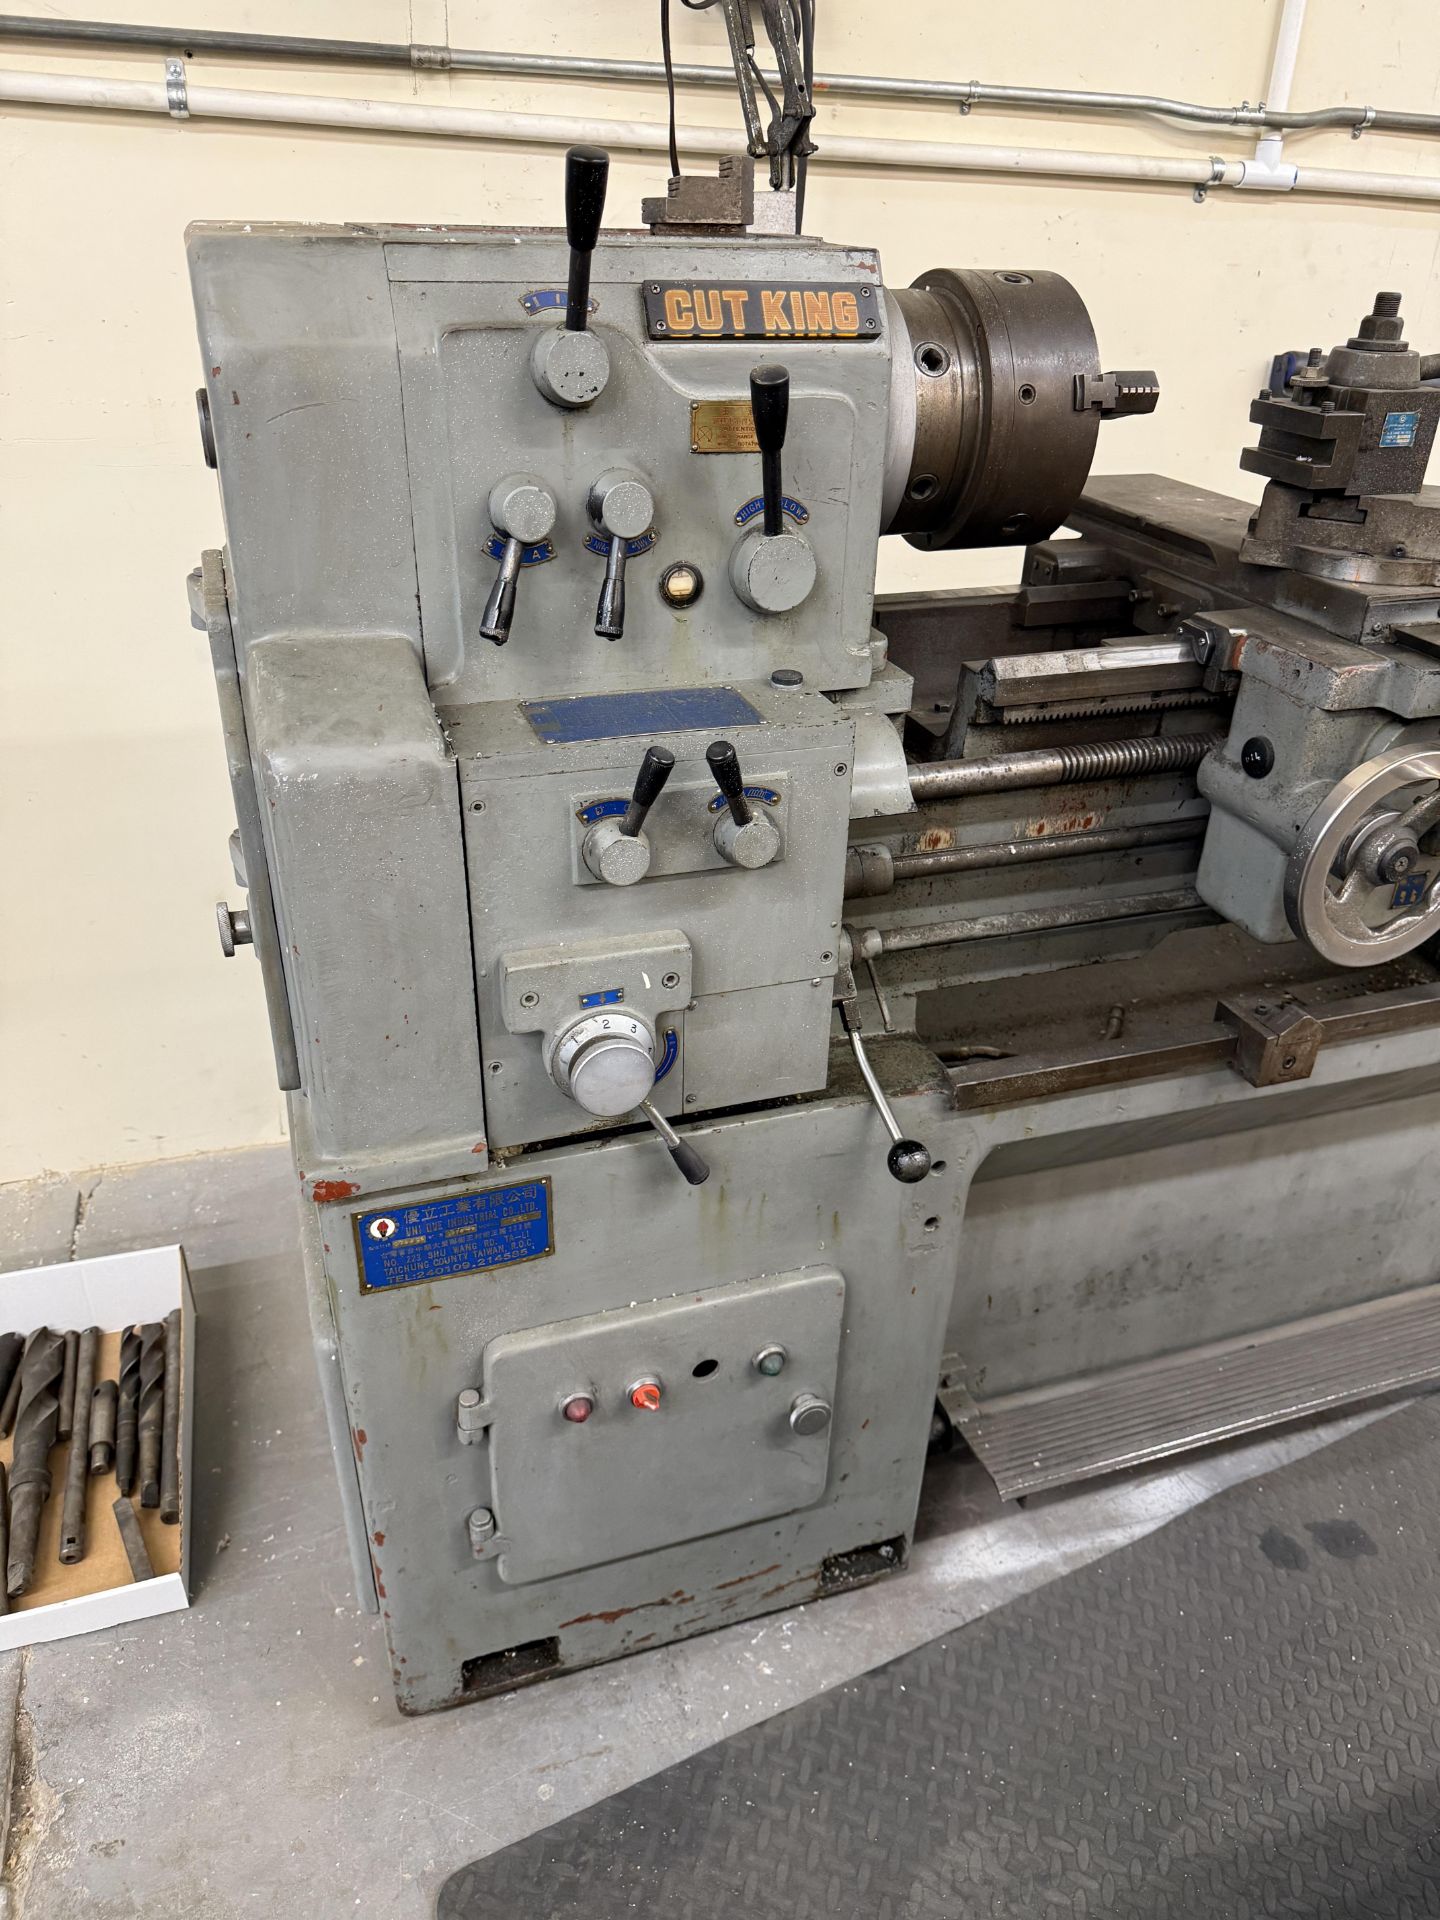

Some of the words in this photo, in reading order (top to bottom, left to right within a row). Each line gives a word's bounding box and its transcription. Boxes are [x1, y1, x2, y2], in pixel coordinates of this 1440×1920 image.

[664, 289, 749, 330] CUT
[760, 291, 859, 331] KING
[740, 500, 761, 519] HIGH
[784, 500, 803, 516] LOW
[532, 549, 541, 559] A
[602, 1019, 611, 1030] 2
[630, 1023, 637, 1034] 3
[447, 1209, 498, 1227] INDUSTRIAL
[383, 1258, 398, 1268] NO.
[427, 1248, 446, 1258] SHU
[453, 1242, 476, 1253] WANG
[484, 1237, 497, 1247] RD.
[384, 1260, 429, 1276] TAICHUNG
[433, 1252, 467, 1266] COUNTY
